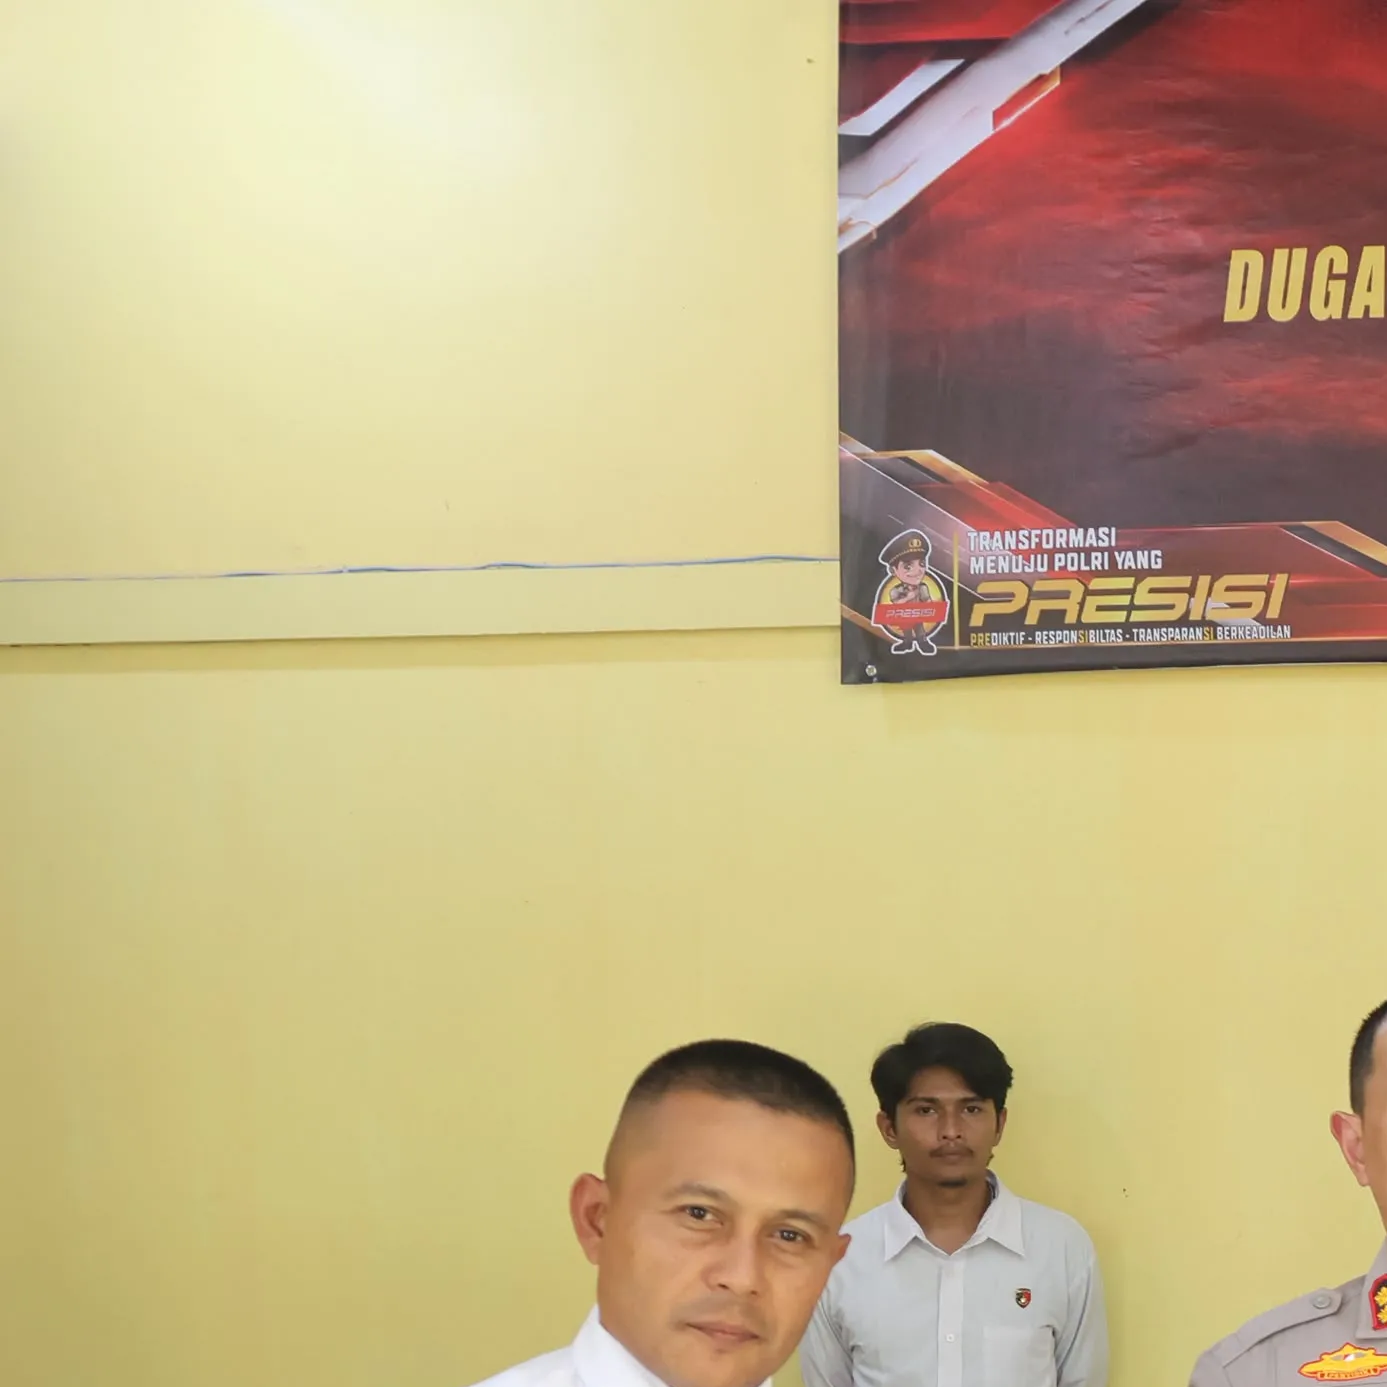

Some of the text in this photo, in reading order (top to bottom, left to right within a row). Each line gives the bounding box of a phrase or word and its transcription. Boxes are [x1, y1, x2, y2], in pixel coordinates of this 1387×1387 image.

[967, 527, 1117, 551] TRANSFORMASI
[969, 550, 1162, 575] MENUJU POLRI YANG
[968, 573, 1291, 627] PRESISI
[970, 632, 1026, 648] PREDIKTIF
[1132, 626, 1214, 642] TRANSPARANSI
[1216, 625, 1291, 640] BERKEADILAN
